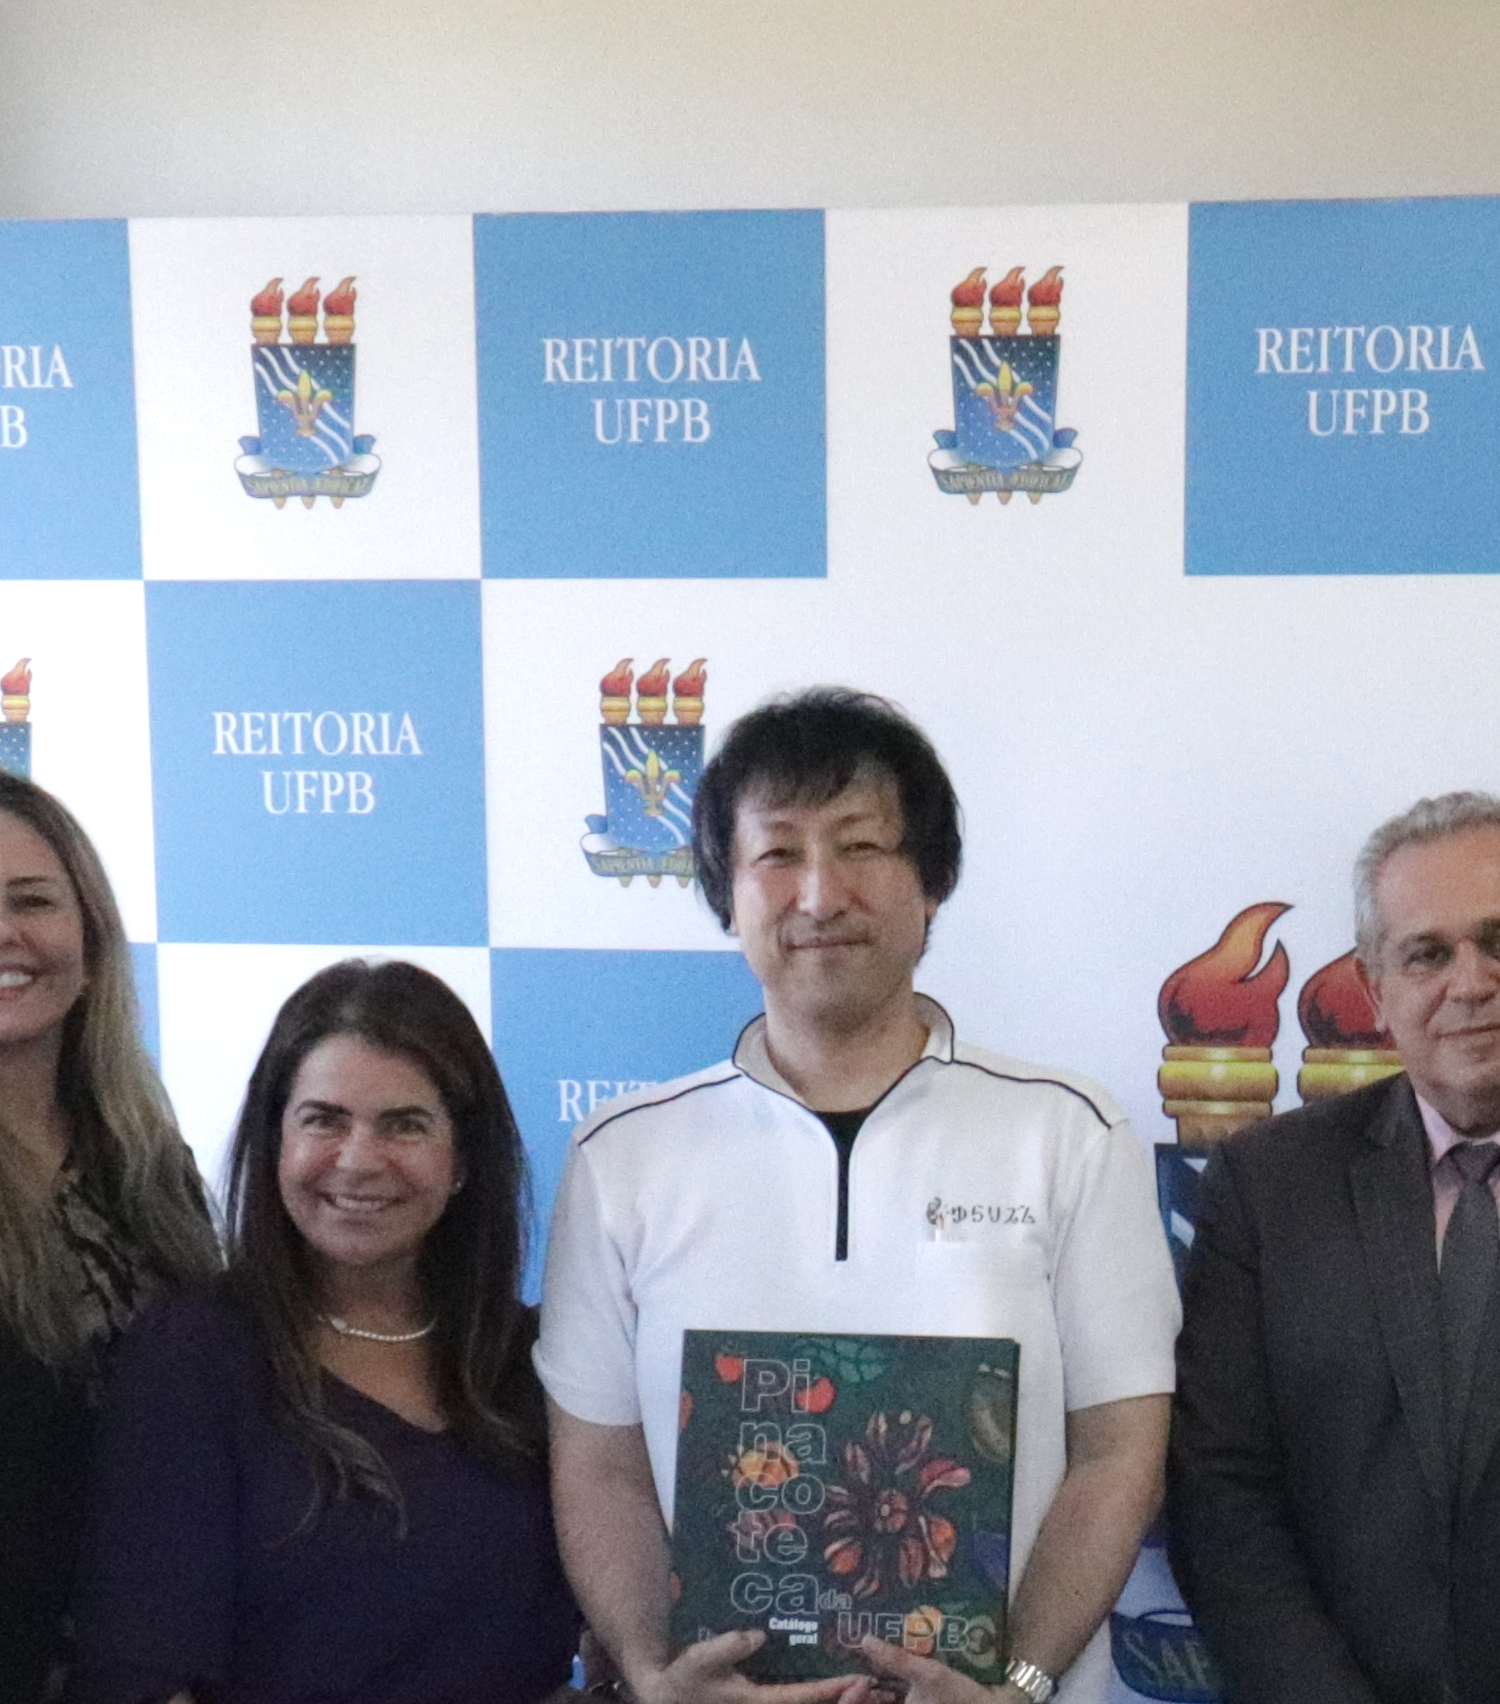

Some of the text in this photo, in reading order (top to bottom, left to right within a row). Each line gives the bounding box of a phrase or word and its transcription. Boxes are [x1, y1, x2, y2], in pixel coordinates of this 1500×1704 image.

[541, 335, 763, 384] REITORIA
[1255, 324, 1487, 374] REITORIA
[593, 397, 713, 445] UFPB
[1307, 387, 1432, 437] UFPB
[212, 710, 423, 757] REITORIA
[261, 769, 378, 816] UFPB
[767, 1616, 819, 1633] Catálogo
[788, 1632, 818, 1647] geral
[837, 1611, 971, 1652] UFPB
